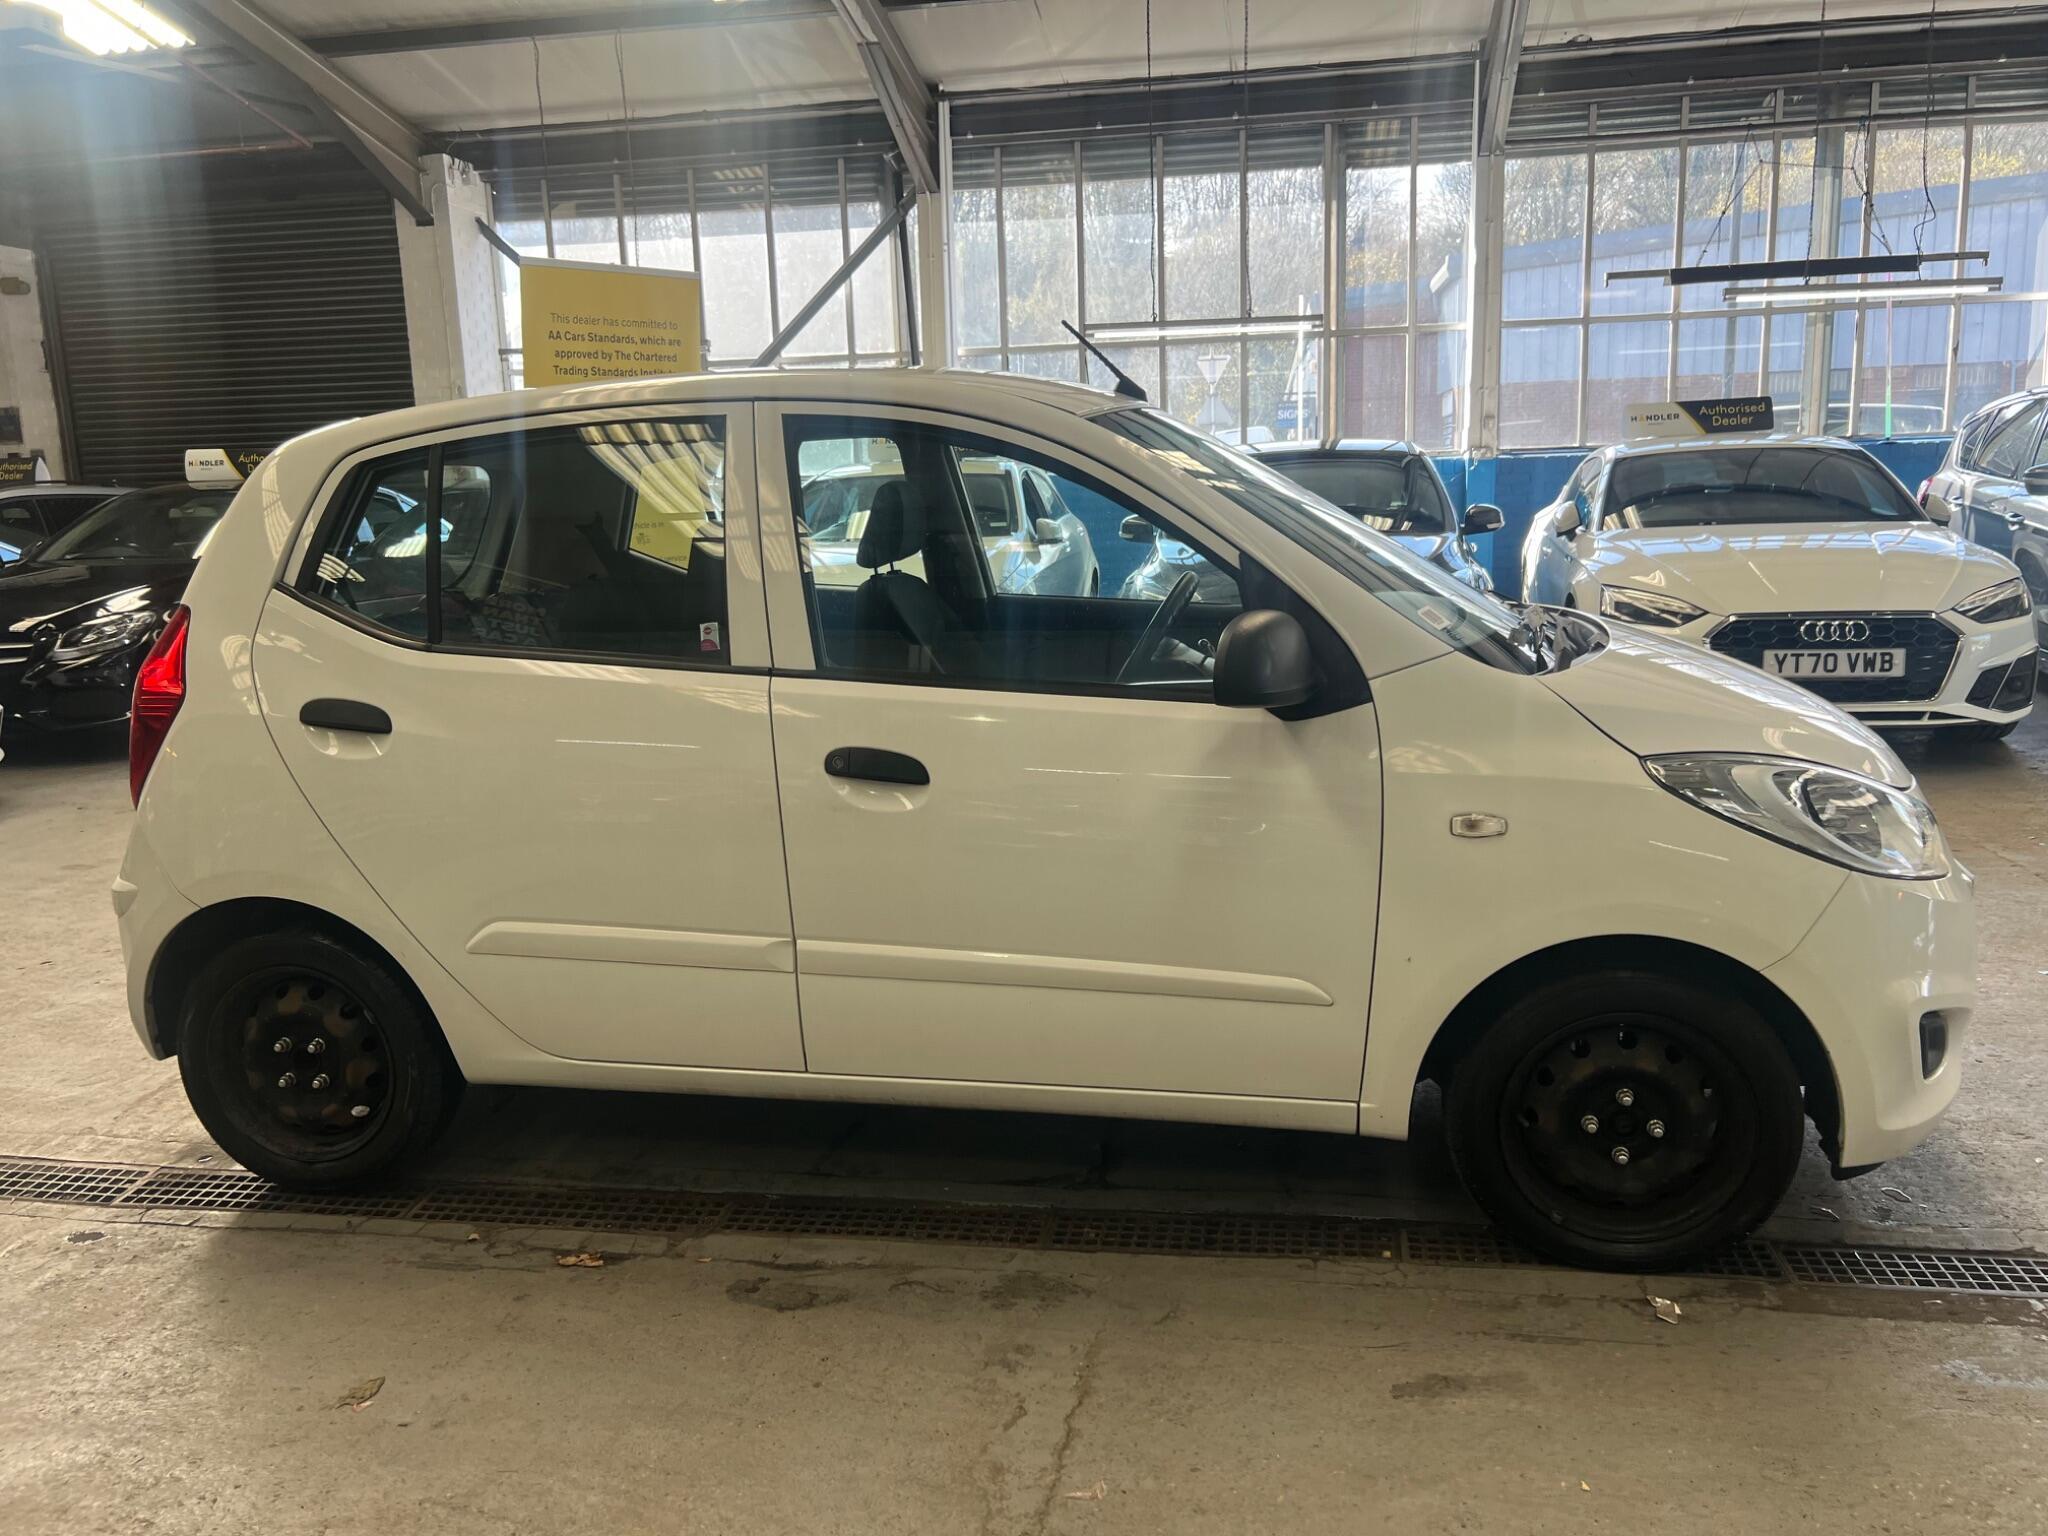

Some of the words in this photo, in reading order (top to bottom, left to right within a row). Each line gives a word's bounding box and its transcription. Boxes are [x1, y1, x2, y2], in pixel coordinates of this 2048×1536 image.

[550, 313, 570, 325] This
[572, 314, 601, 326] dealer
[603, 316, 620, 328] has
[621, 318, 667, 330] committed
[668, 320, 678, 330] to
[548, 330, 562, 341] AA
[564, 332, 586, 343] Cars
[587, 333, 638, 346] Standards,
[640, 335, 666, 347] which
[667, 338, 681, 347] are
[554, 349, 600, 361] approved
[601, 350, 613, 362] by
[614, 351, 631, 361] The
[633, 352, 678, 363] Chartered
[553, 365, 588, 378] Trading
[590, 366, 639, 377] Standards
[1277, 409, 1308, 420] SIGS
[1699, 402, 1766, 416] Authorised
[1630, 413, 1680, 423] HANDLER
[1712, 415, 1753, 427] Dealer
[188, 459, 225, 468] HANDLER
[239, 453, 265, 464] Autho
[0, 462, 32, 472] uthorised
[0, 471, 24, 480] Dealer
[1774, 653, 1838, 674] YT70
[1846, 651, 1894, 673] VWB
